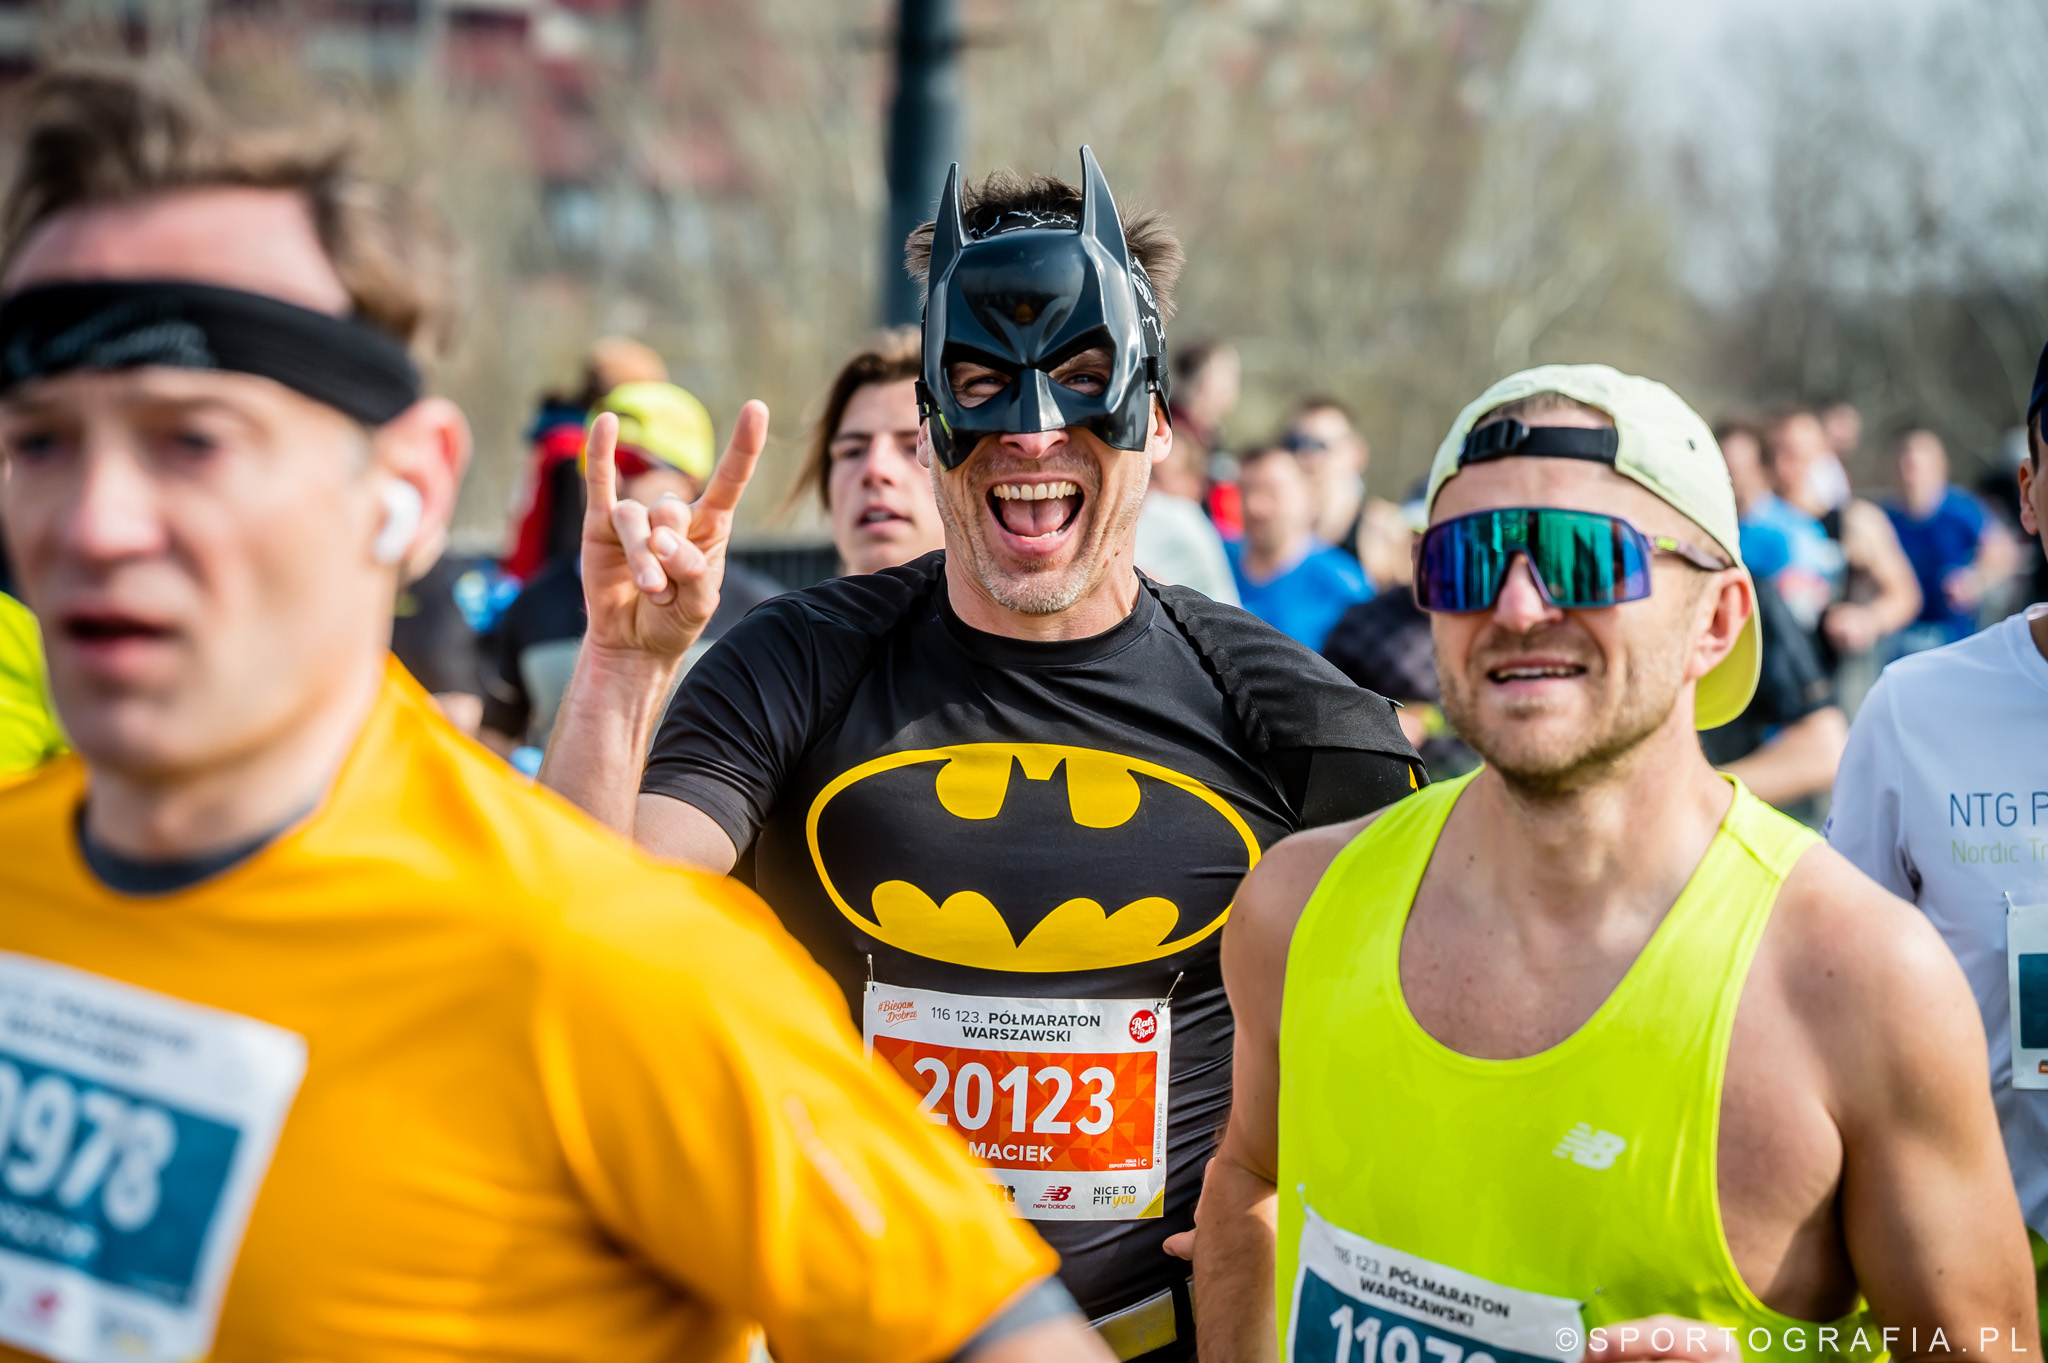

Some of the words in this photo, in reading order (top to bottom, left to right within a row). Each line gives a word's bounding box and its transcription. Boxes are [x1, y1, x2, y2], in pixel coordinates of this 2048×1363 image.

[1950, 792, 2018, 828] NTG
[1951, 839, 2020, 865] Nordic
[931, 1006, 951, 1021] 116
[955, 1010, 983, 1024] 123.
[988, 1009, 1101, 1028] PÓŁMARATON
[1131, 1016, 1155, 1031] Rak
[962, 1026, 1071, 1043] WARSZAWSKI
[912, 1057, 1116, 1135] 20123
[968, 1142, 1053, 1163] MACIEK
[1140, 1158, 1148, 1166] C
[1094, 1187, 1119, 1195] NICE
[1122, 1186, 1136, 1195] TO
[1048, 1202, 1076, 1210] balance
[1093, 1195, 1112, 1205] FIT
[1112, 1195, 1136, 1209] you
[1359, 1277, 1475, 1328] WARSZAWSKI
[1388, 1265, 1511, 1319] PÓŁMARATON
[1329, 1303, 1499, 1363] 1197
